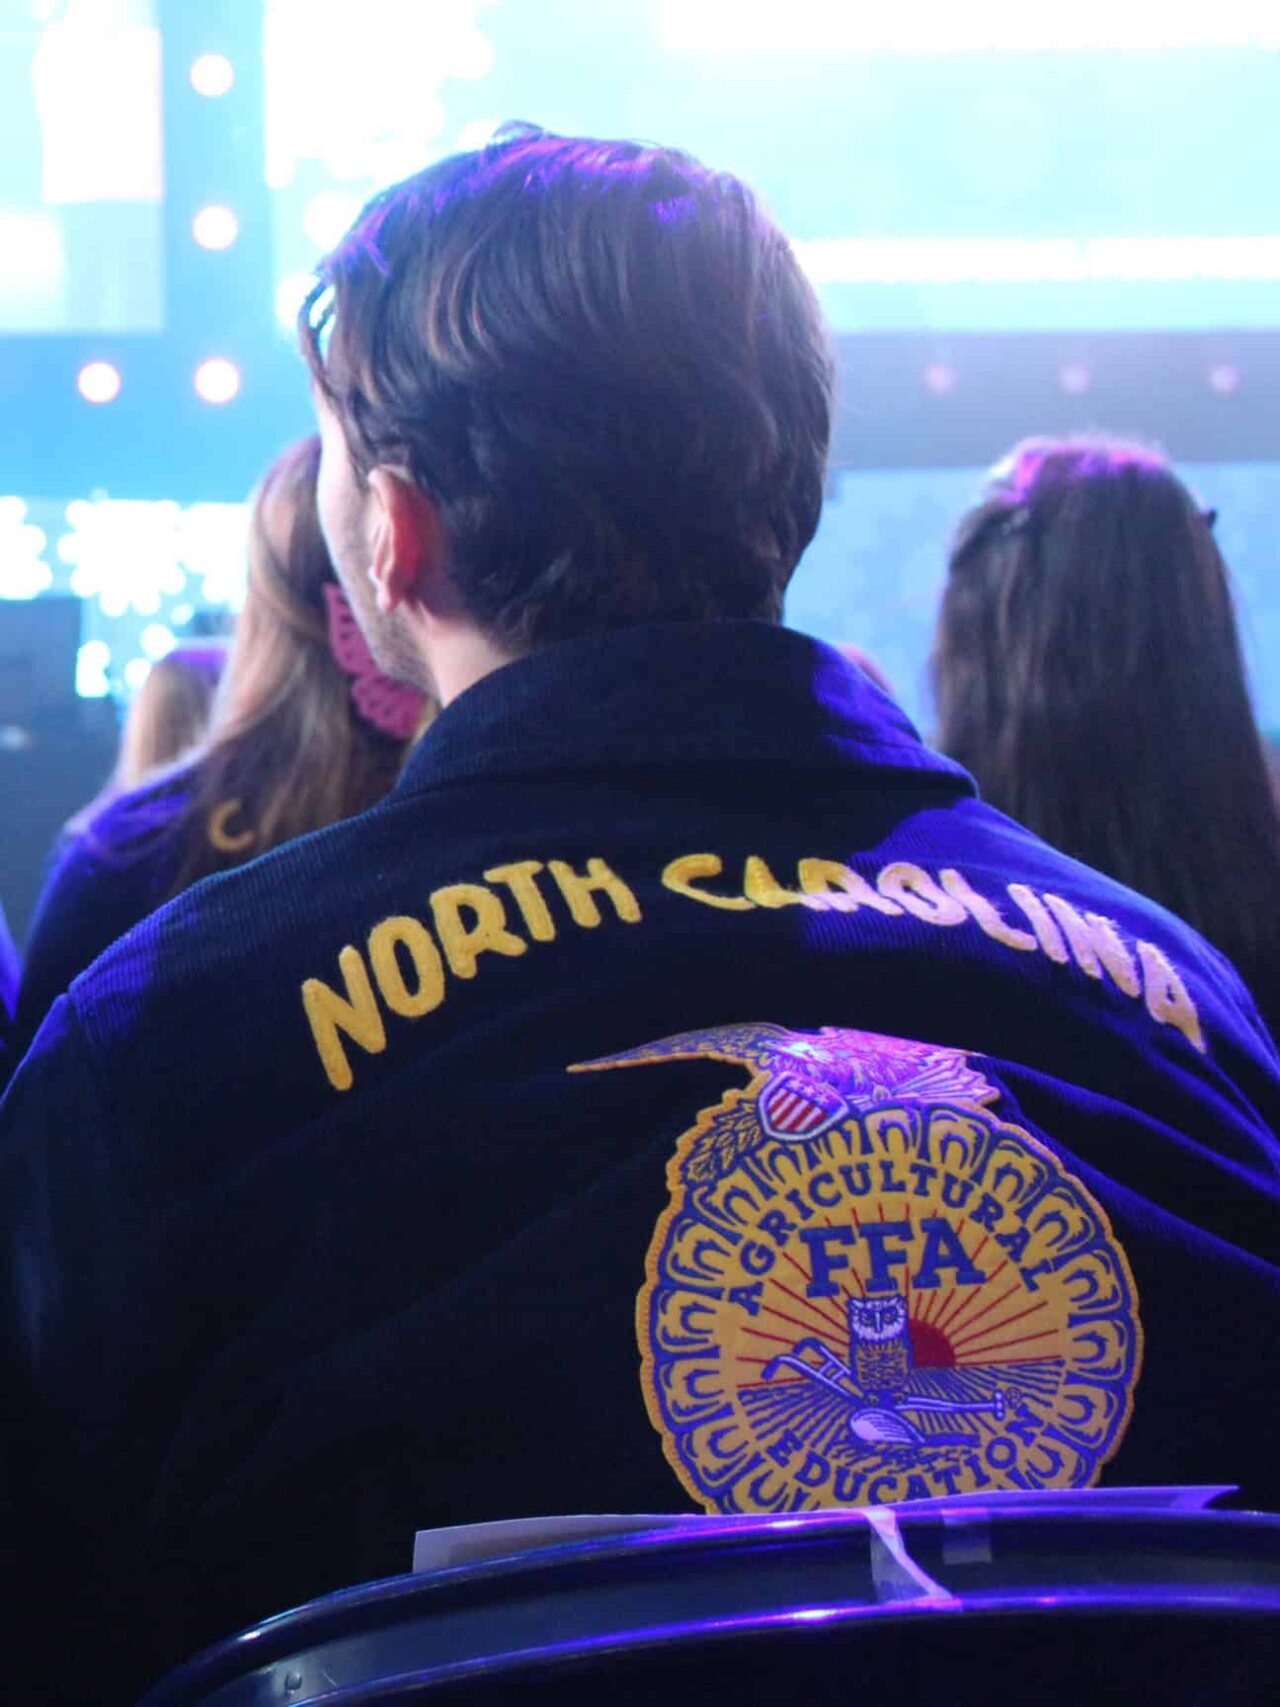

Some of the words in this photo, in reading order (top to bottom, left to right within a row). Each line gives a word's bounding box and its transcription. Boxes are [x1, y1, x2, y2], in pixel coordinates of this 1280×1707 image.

[301, 857, 643, 1091] NORTH
[728, 1160, 1056, 1317] AGRICULTURAL
[799, 1217, 987, 1298] FFA
[767, 1402, 1044, 1506] EDUCATION
